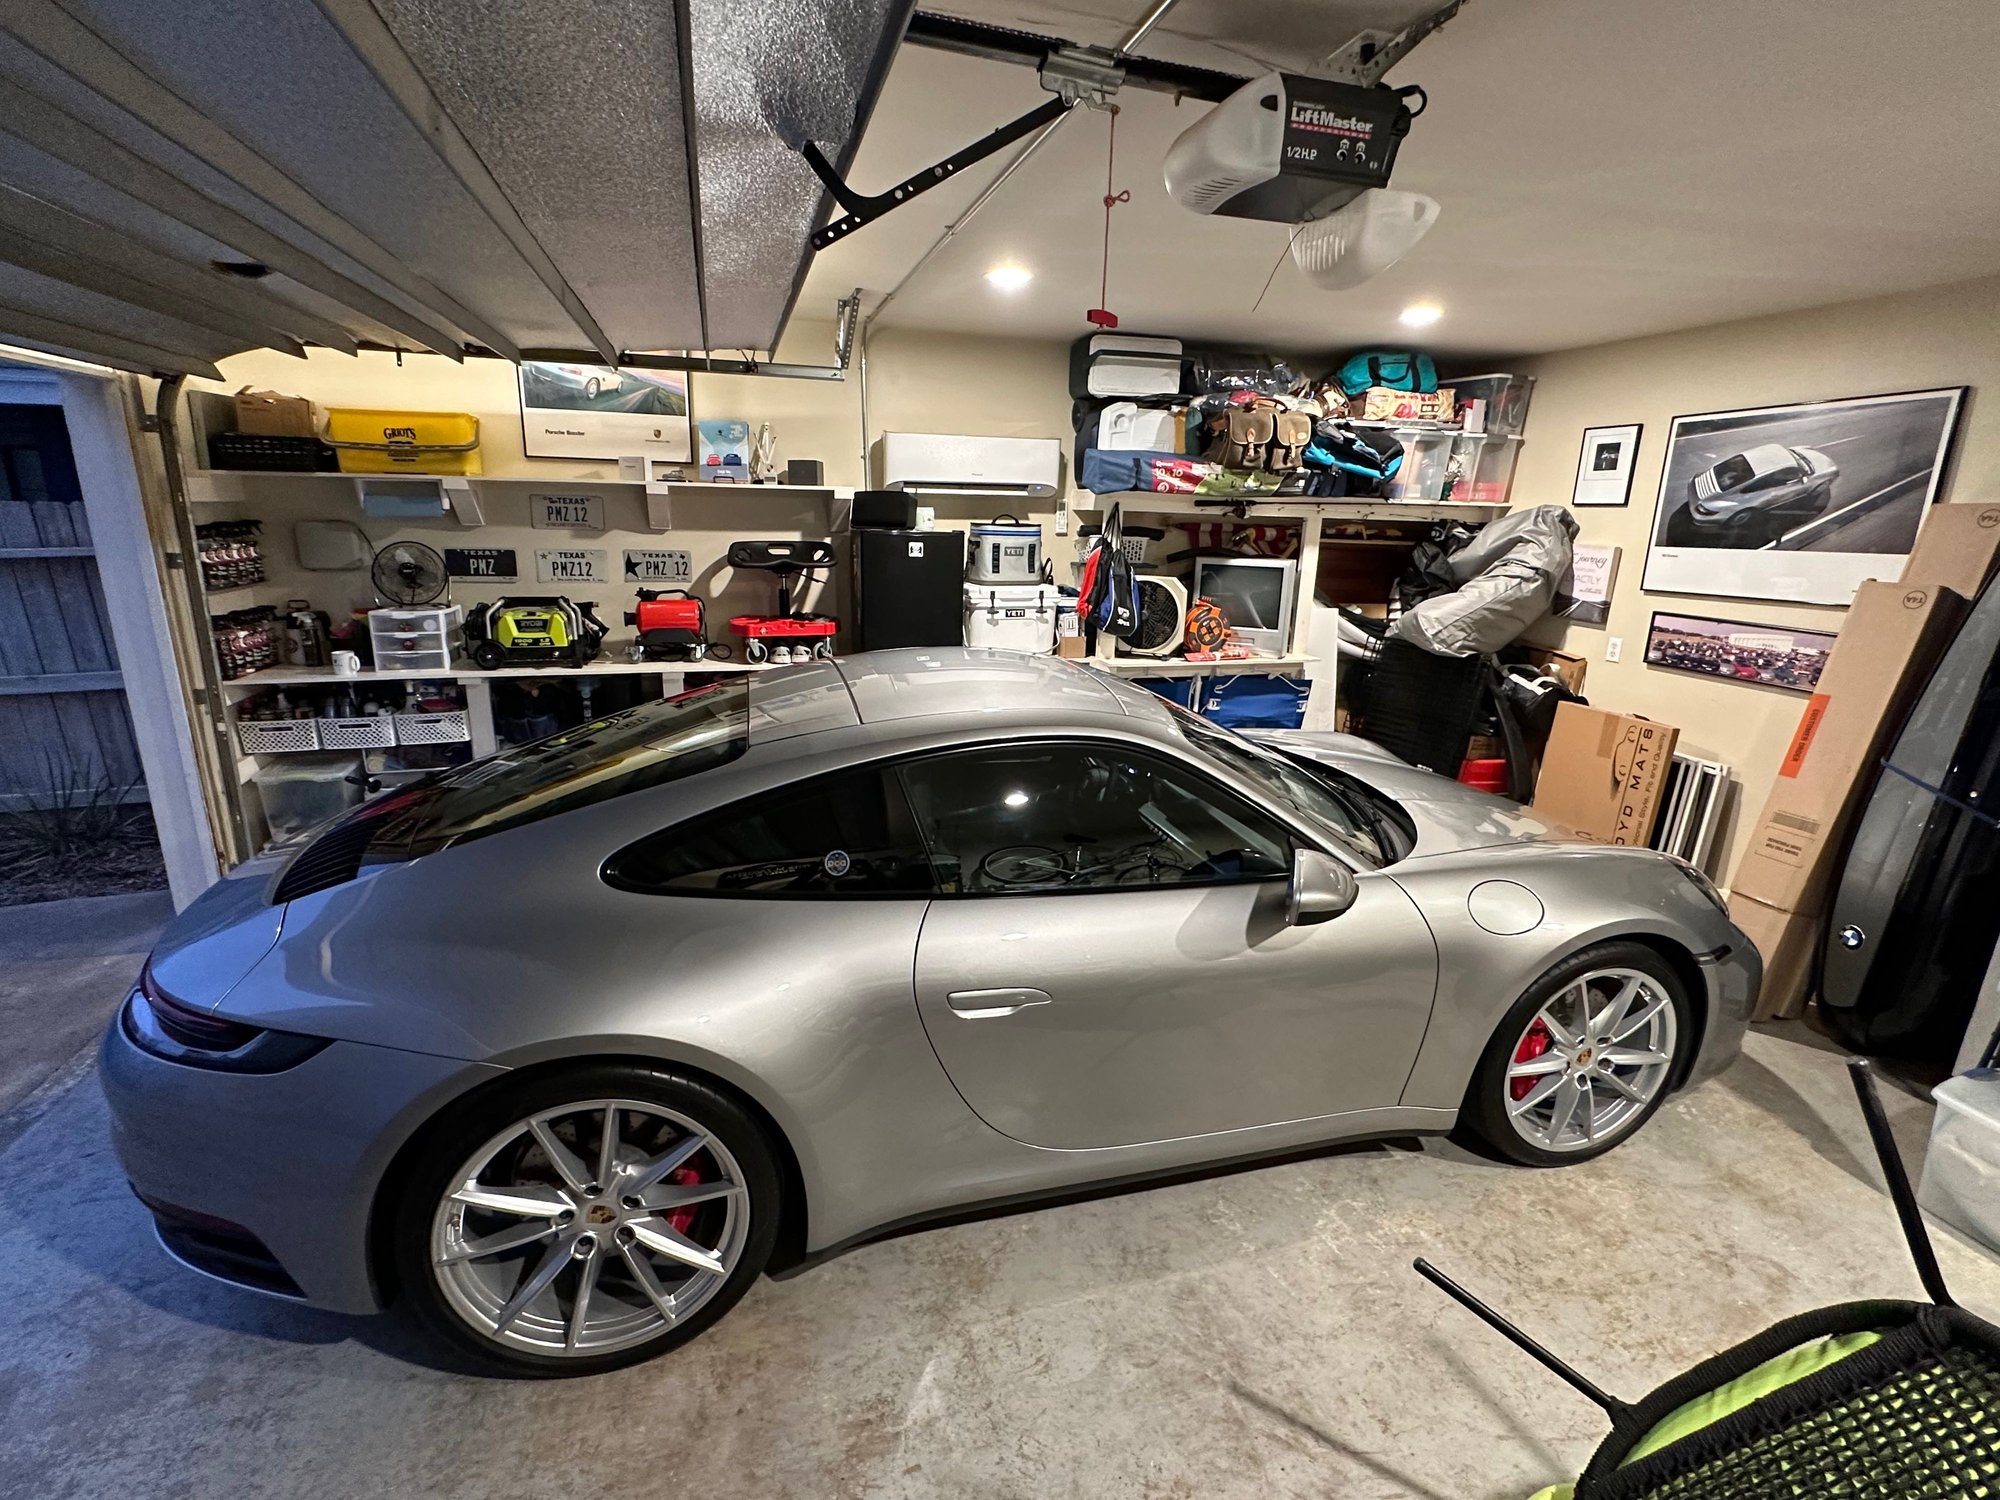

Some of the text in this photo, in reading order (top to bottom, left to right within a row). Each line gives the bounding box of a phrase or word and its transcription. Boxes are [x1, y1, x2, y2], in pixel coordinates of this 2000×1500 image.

[1291, 107, 1373, 132] LiftMaster
[547, 506, 588, 522] PMZ 12
[469, 558, 495, 574] PMZ
[646, 561, 689, 575] PMZ 12
[1575, 574, 1602, 585] ACTLY
[1653, 732, 1667, 761] Quality
[1650, 763, 1658, 779] and
[1615, 728, 1654, 846] OYD MATS
